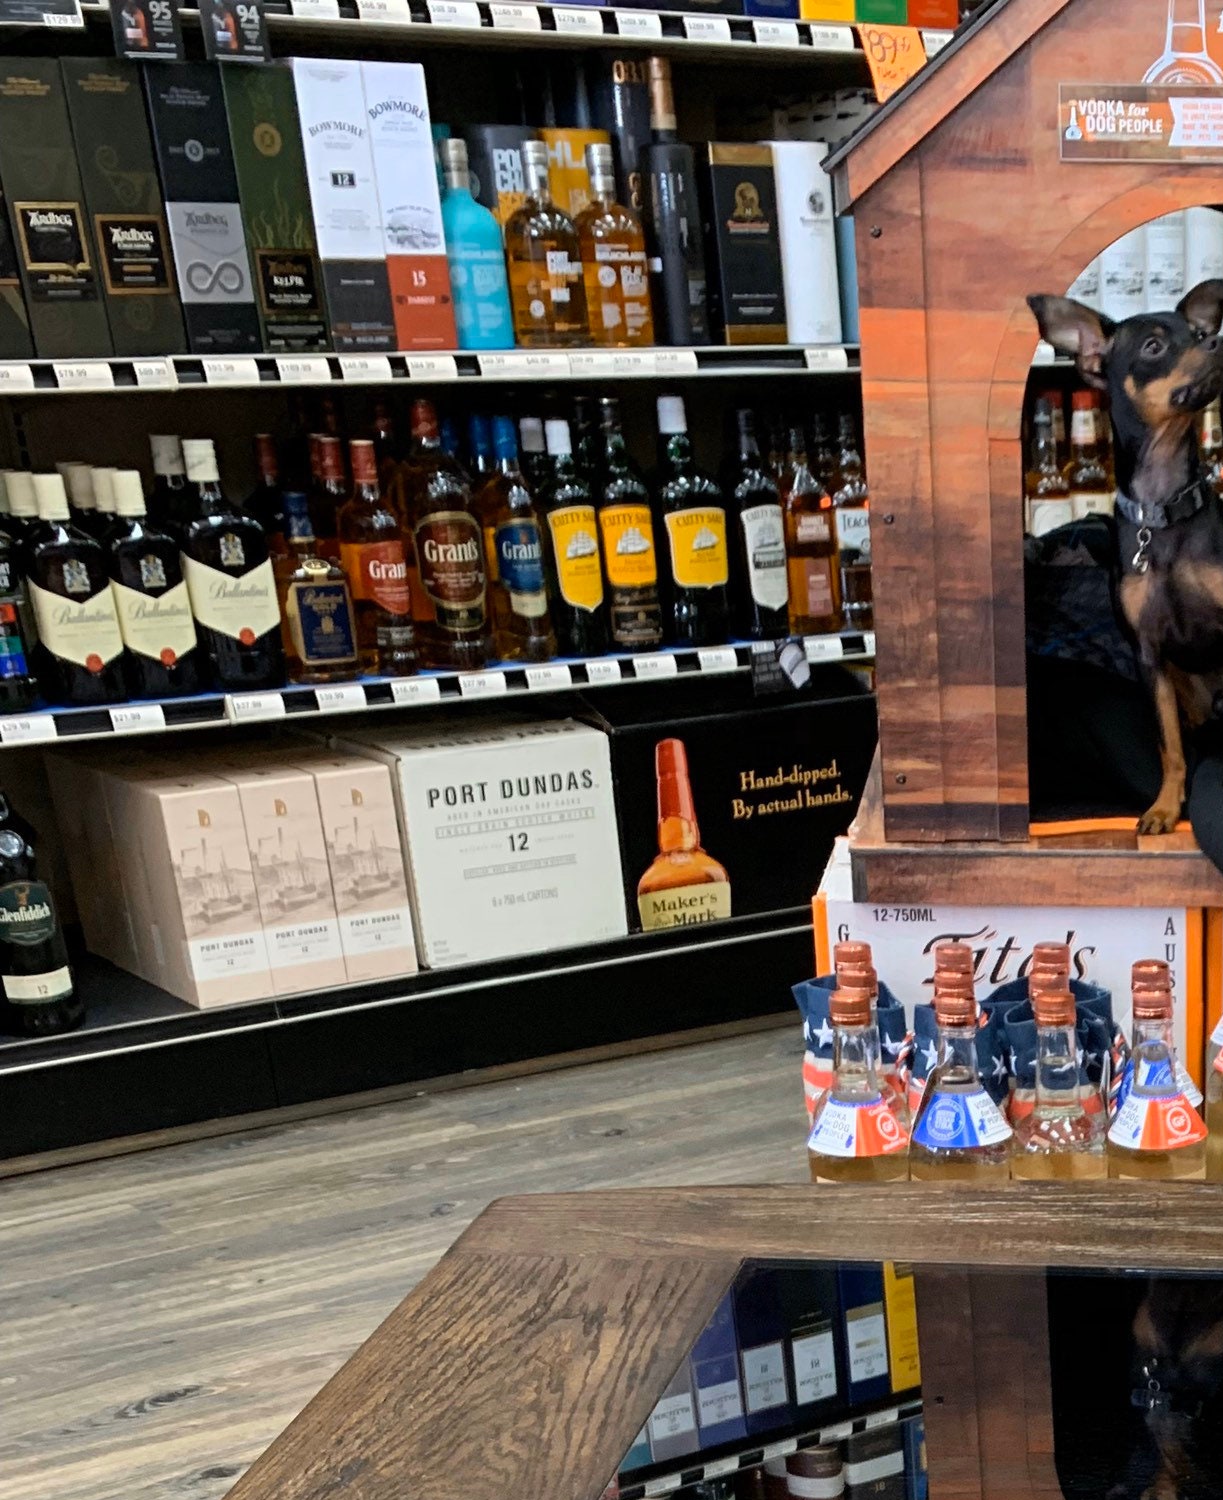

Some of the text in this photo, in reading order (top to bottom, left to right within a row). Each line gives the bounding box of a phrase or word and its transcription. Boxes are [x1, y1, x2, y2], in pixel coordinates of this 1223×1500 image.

[150, 2, 172, 19] 95
[236, 5, 259, 22] 94
[368, 100, 427, 121] BOWMORE
[1078, 100, 1150, 117] VODKA for
[308, 120, 366, 138] BOWMORE
[1086, 116, 1163, 133] DOG PEOPLE
[412, 270, 426, 286] 15
[740, 760, 842, 791] Hand-dipped.
[427, 769, 593, 808] PORT DUNDAS
[733, 784, 853, 818] By actual hands.
[507, 832, 530, 852] 12
[527, 887, 559, 902] CARTONS
[652, 892, 718, 914] Maker's
[673, 908, 717, 926] Mark
[873, 909, 937, 923] 12-750ML
[37, 984, 49, 995] 12
[832, 1121, 850, 1133] DOG
